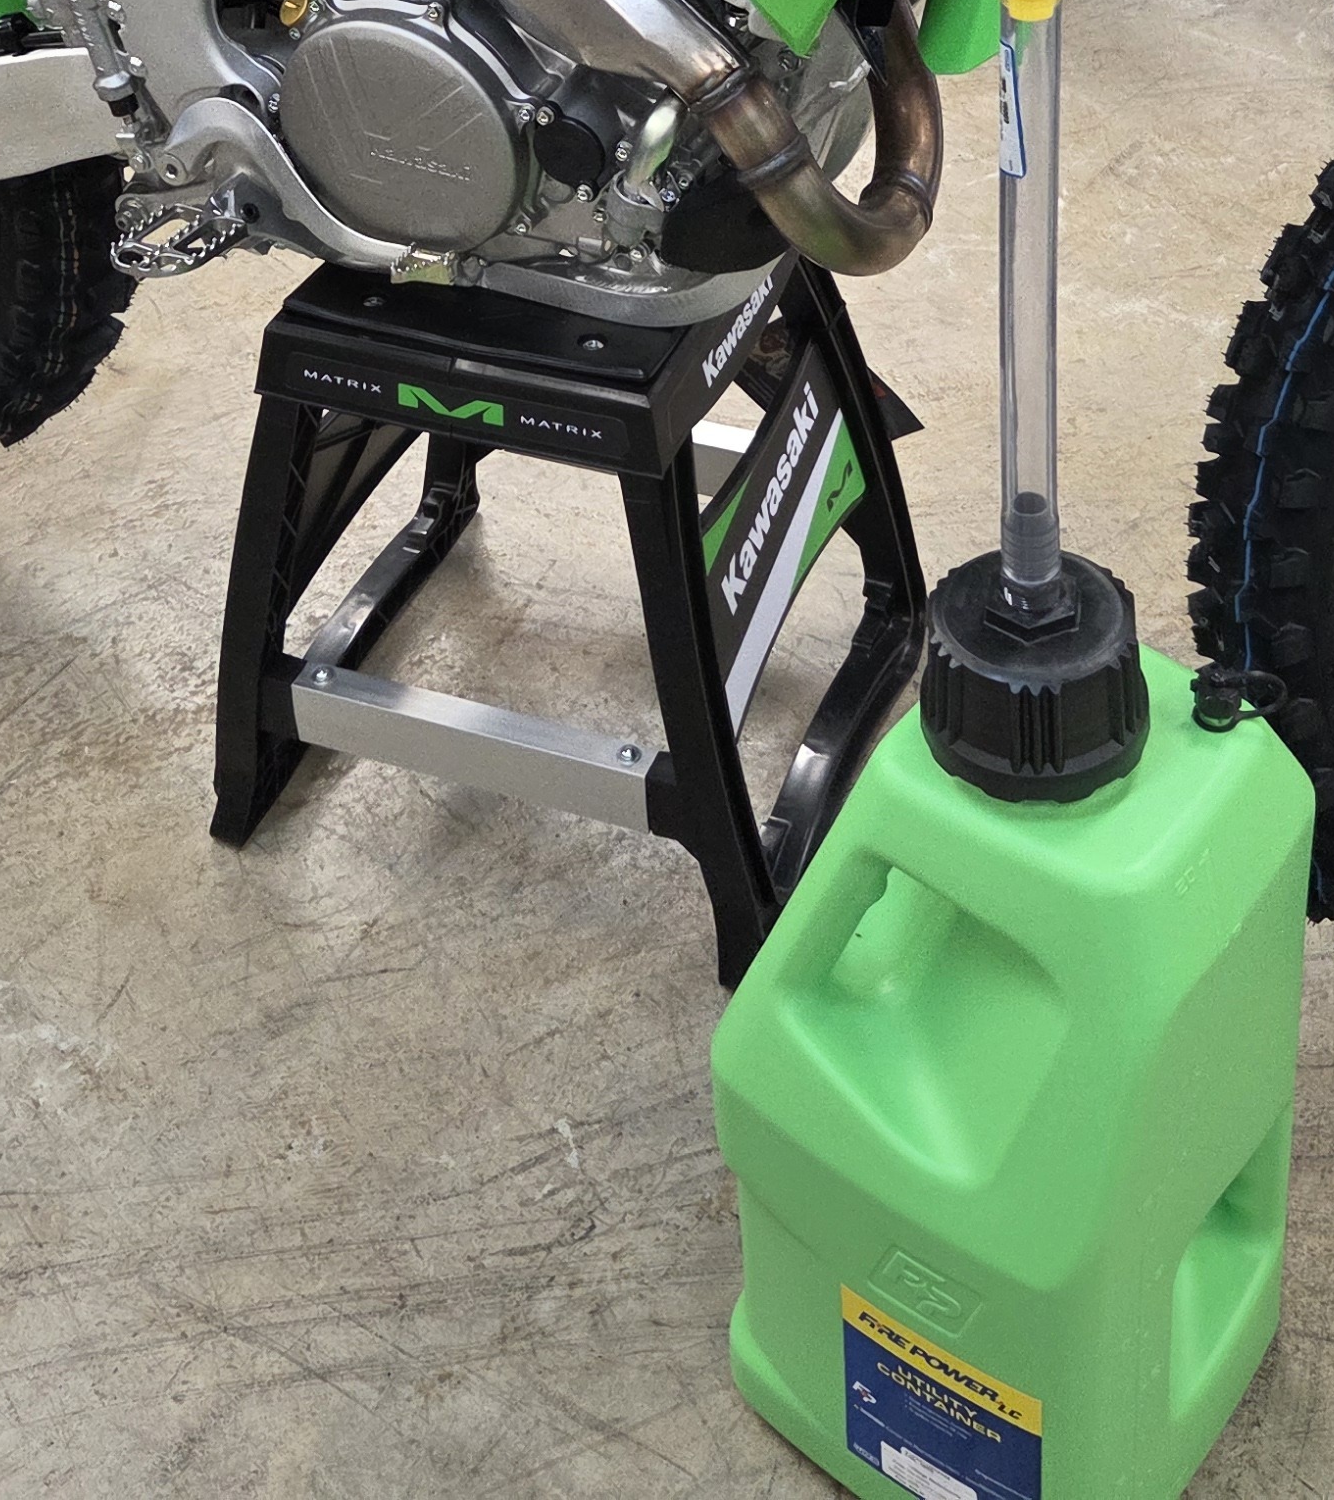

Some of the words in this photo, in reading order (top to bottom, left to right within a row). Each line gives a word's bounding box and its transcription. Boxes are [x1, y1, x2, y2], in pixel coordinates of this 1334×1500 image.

[701, 274, 775, 389] Kawasaki
[304, 368, 382, 394] MATRIX
[520, 414, 604, 441] MATRIX
[722, 382, 821, 617] Kawasaki
[876, 1361, 1002, 1444] CONTAINER
[897, 1365, 977, 1419] UTILITY
[910, 1344, 998, 1403] POWER
